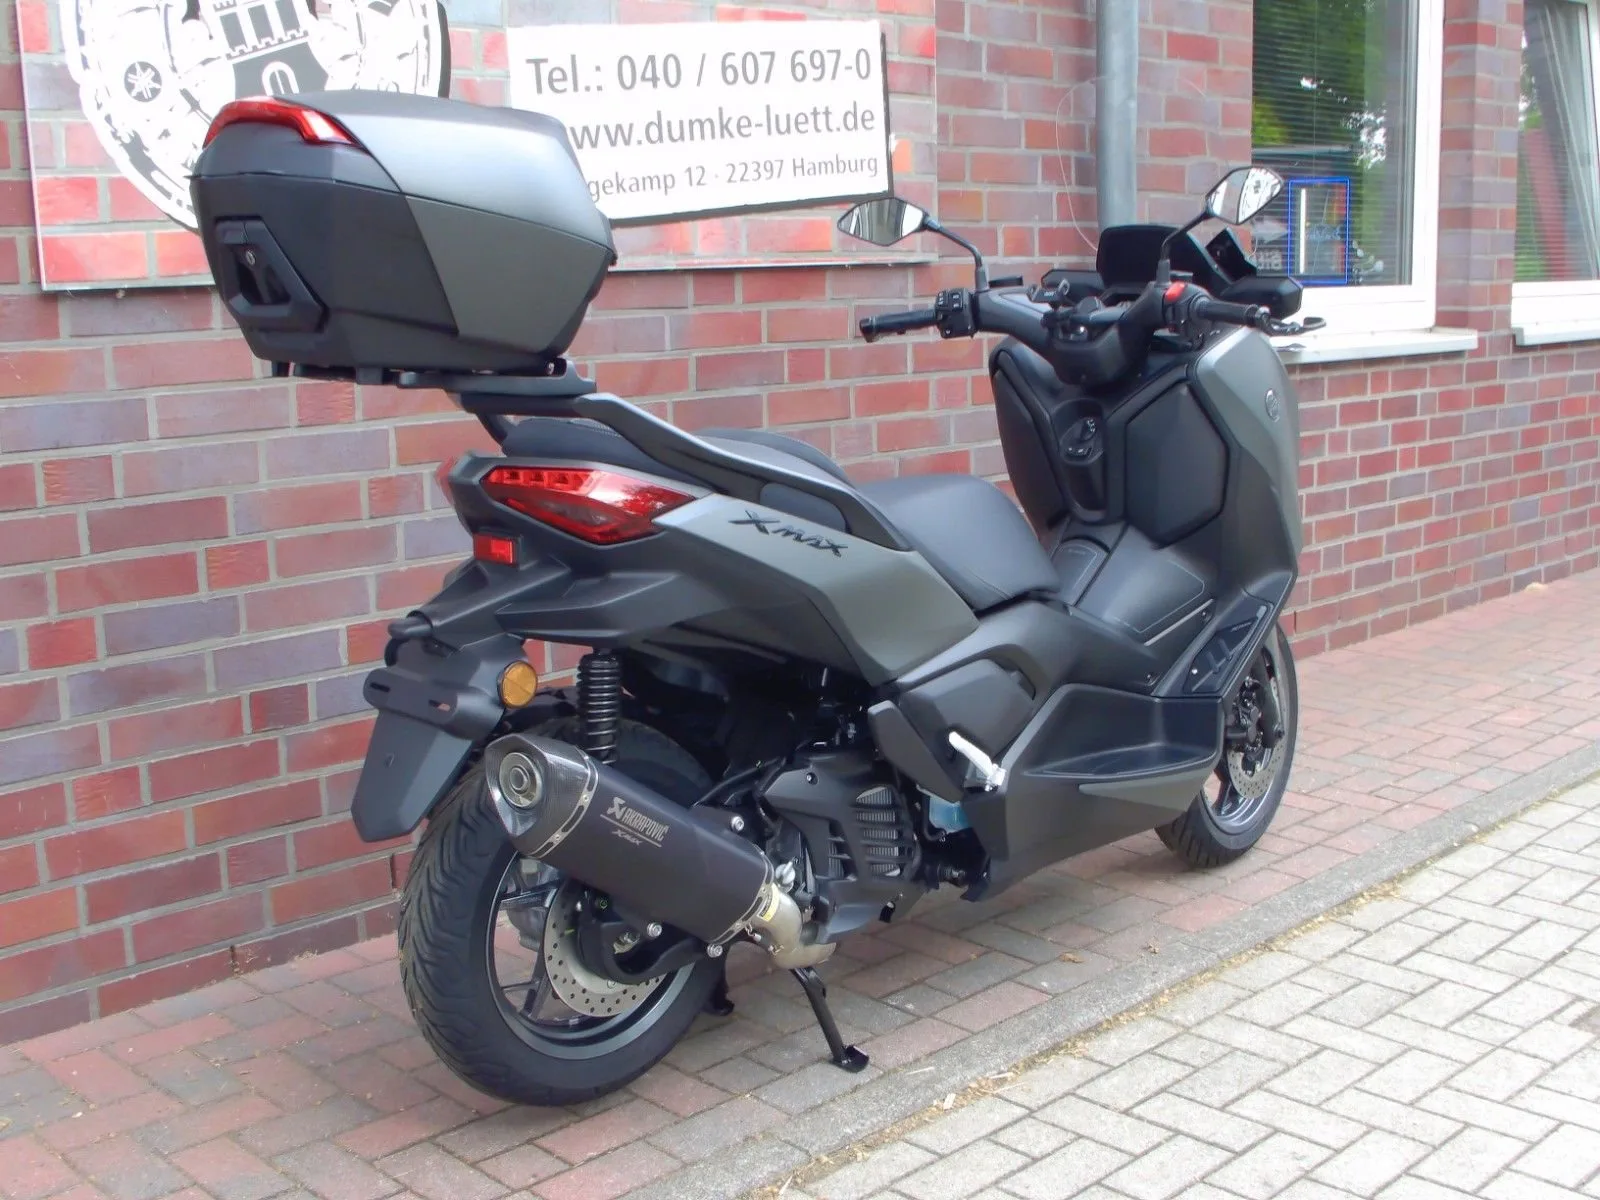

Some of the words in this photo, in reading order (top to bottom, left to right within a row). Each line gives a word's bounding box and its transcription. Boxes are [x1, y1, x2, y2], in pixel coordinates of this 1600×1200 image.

[526, 55, 603, 95] Tel.:
[617, 53, 682, 91] 040
[696, 53, 706, 87] /
[720, 51, 776, 85] 607
[790, 48, 871, 82] 697-0
[569, 101, 876, 150] ww.dumke-luett.de
[588, 171, 676, 203] gekamp
[684, 166, 706, 188] 12
[726, 159, 784, 184] 22397
[792, 154, 878, 178] Hamburg
